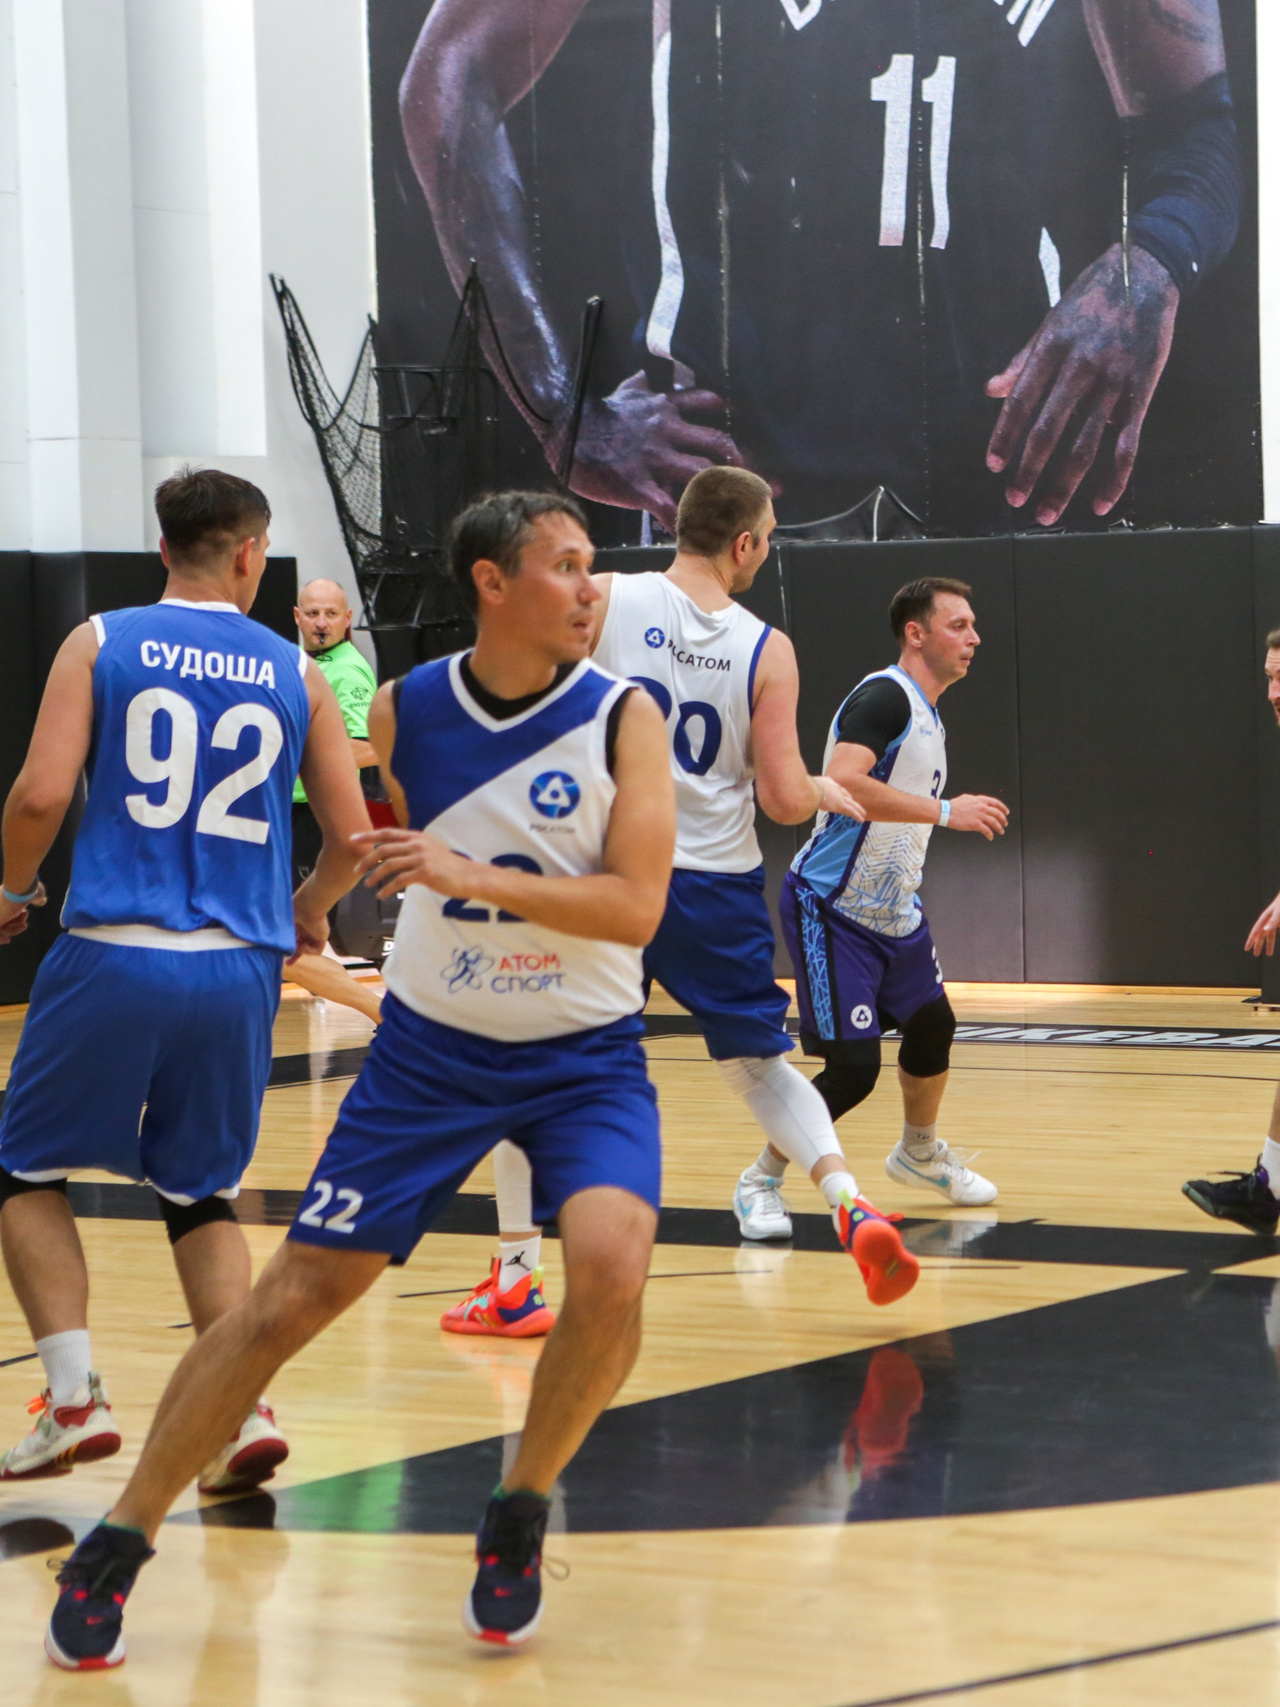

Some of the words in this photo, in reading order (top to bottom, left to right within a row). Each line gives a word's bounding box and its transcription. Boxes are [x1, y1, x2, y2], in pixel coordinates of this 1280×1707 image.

[870, 53, 957, 249] 11
[140, 640, 276, 690] СУДОША
[125, 686, 284, 846] 92
[490, 973, 566, 994] СПОРТ
[499, 953, 562, 973] АТОМ
[298, 1180, 364, 1235] 22
